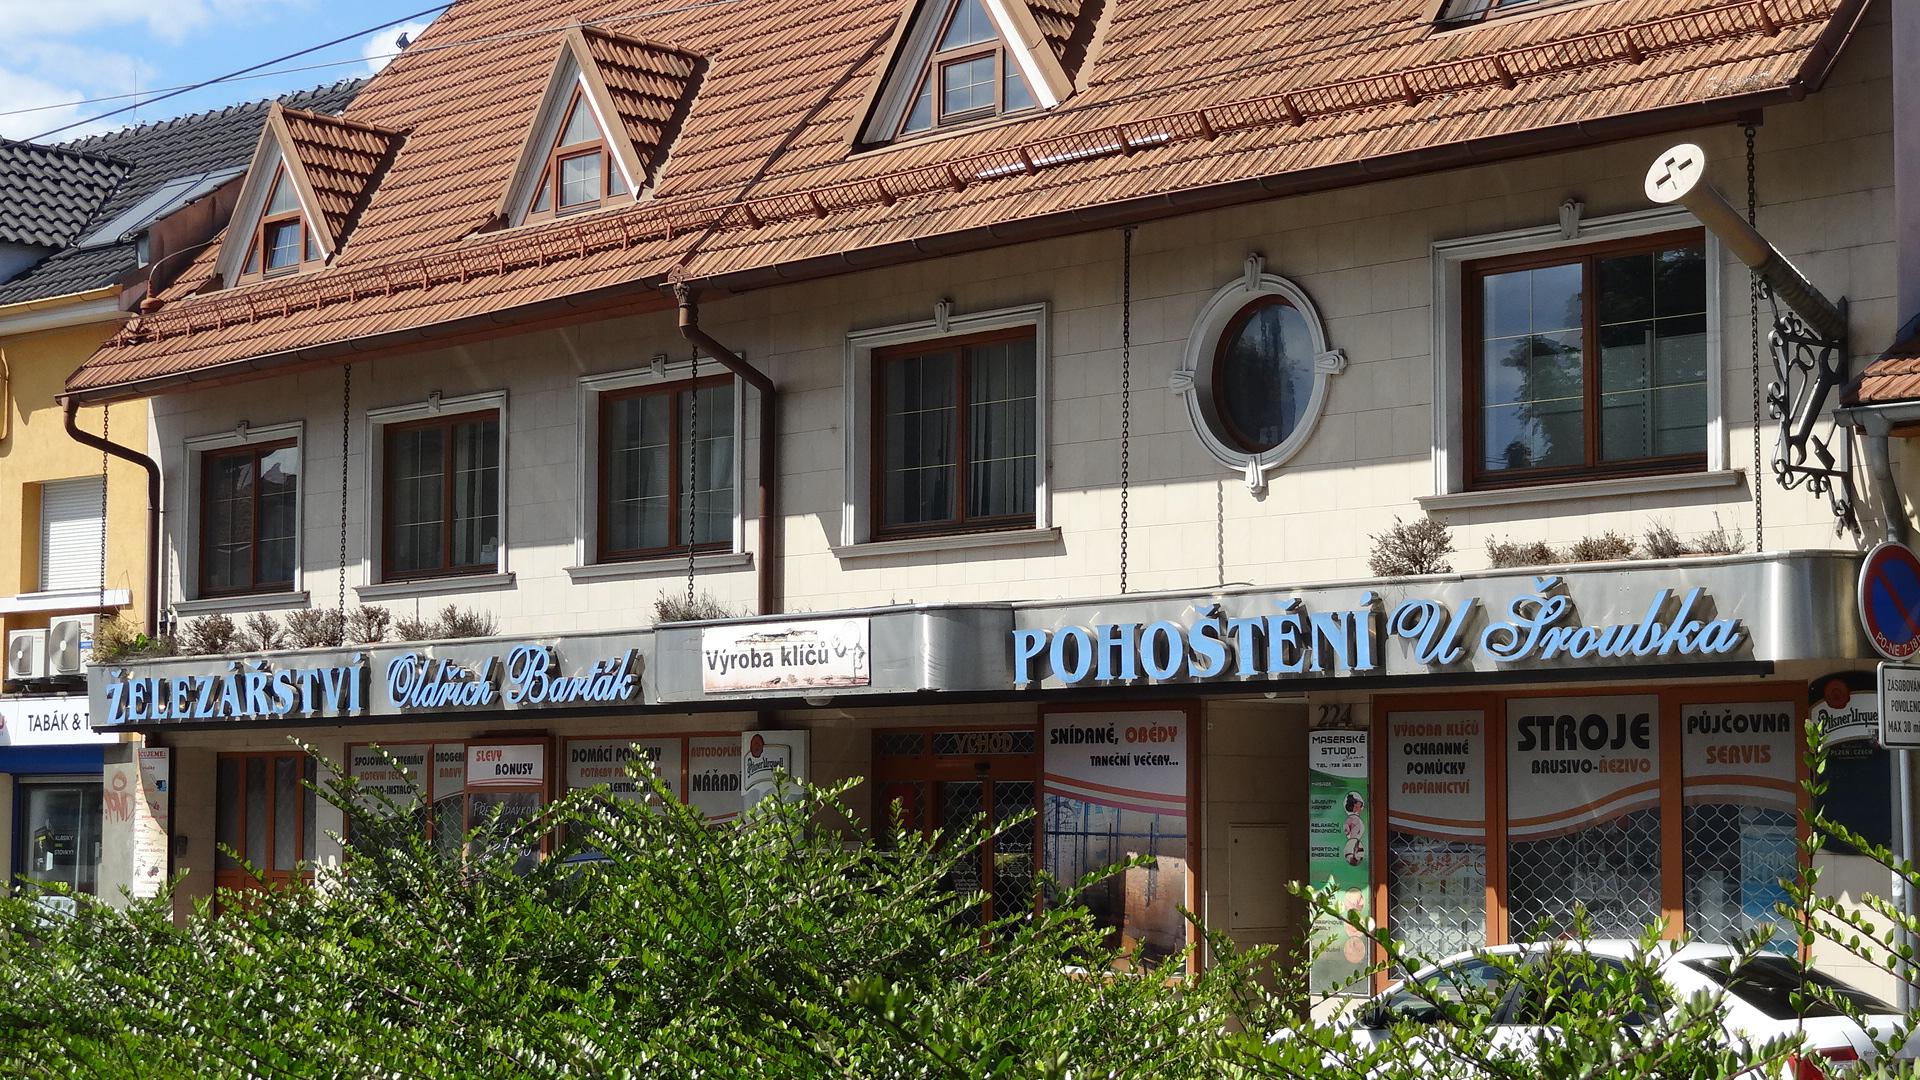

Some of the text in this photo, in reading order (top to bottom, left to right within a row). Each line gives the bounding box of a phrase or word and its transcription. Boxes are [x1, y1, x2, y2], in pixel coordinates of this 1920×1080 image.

[1012, 576, 1744, 686] POHOŠTĚNÍ U Šroubka
[1876, 632, 1900, 656] PO-NE
[705, 640, 829, 676] Výroba klíčů
[106, 644, 634, 725] ŽELEZÁŘSTVÍ Oldřich Barták
[28, 710, 69, 731] TABÁK
[72, 713, 81, 731] &
[1317, 704, 1355, 727] 224
[1687, 709, 1790, 734] PŮJČOVNA
[1818, 708, 1851, 738] Pilsner
[1050, 721, 1178, 745] SNÍDANĚ, OBĚDY
[1393, 721, 1442, 736] VÝROBA
[1517, 713, 1650, 752] STROJE
[1888, 721, 1902, 733] MAX
[1312, 734, 1366, 744] MASERSKÉ
[1403, 739, 1469, 755] OCHRANNÉ
[476, 749, 502, 762] SLEVY
[572, 745, 613, 762] DOMÁCÍ
[1090, 751, 1179, 767] TANEČNÍ VEČERY...
[1321, 747, 1356, 756] STUDIO
[1706, 744, 1771, 764] SERVIS
[495, 763, 534, 776] BONUSY
[1406, 758, 1466, 775] POMŮCKY
[1532, 755, 1651, 774] BRUSIVO-ŘEZIVO
[692, 769, 742, 791] NÁŘADÍ
[1401, 779, 1470, 794] PAPÍRNICTVÍ
